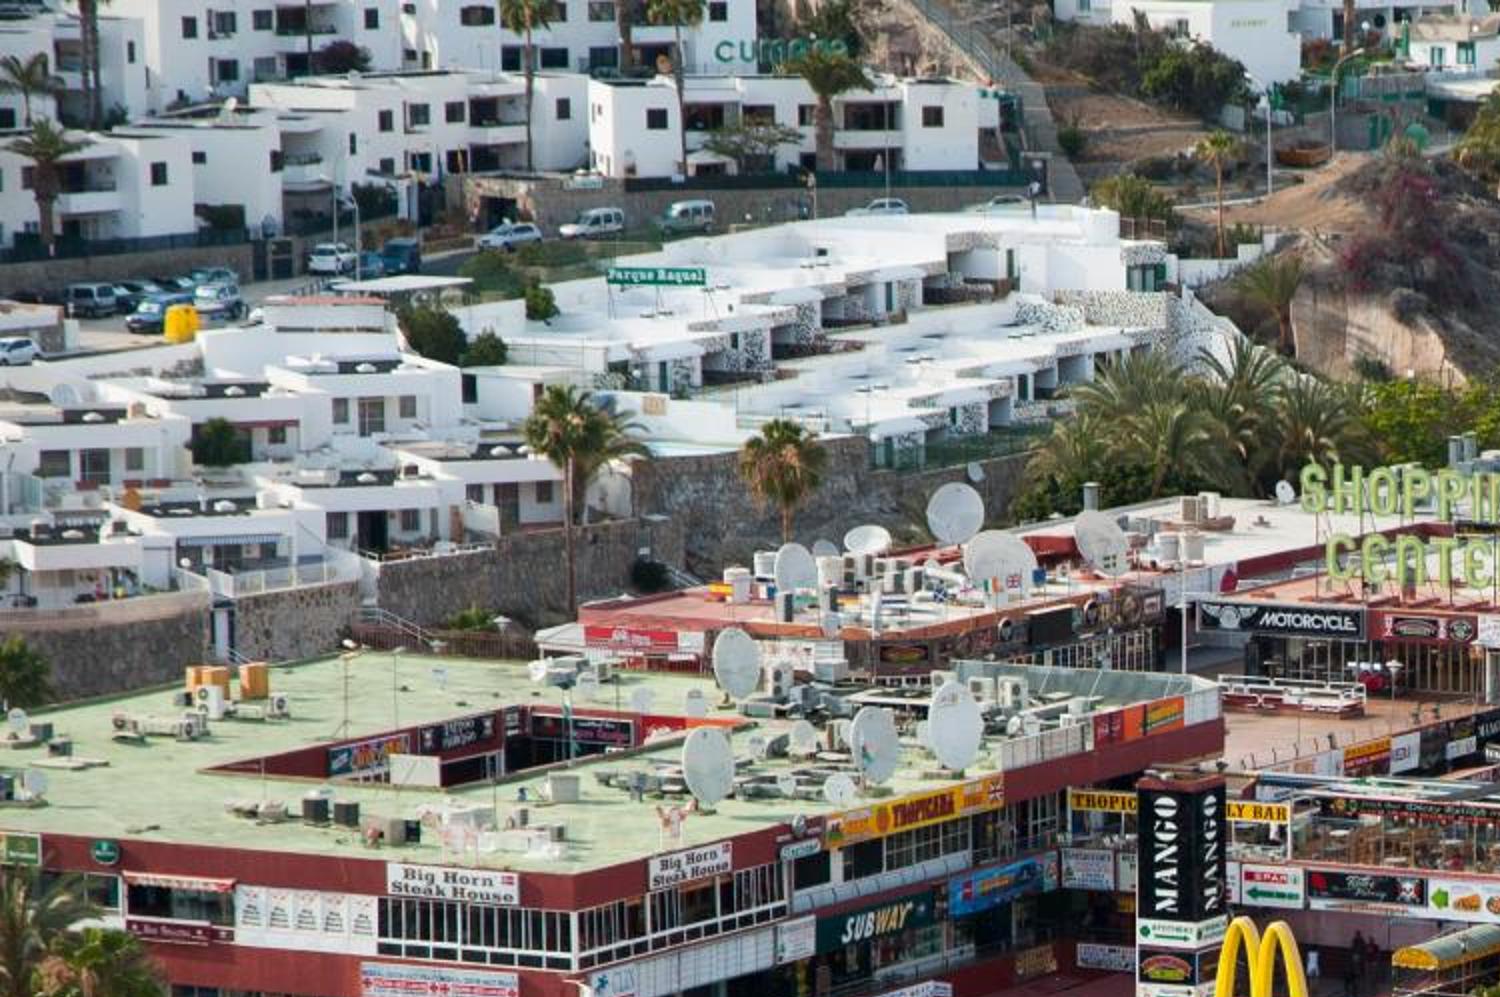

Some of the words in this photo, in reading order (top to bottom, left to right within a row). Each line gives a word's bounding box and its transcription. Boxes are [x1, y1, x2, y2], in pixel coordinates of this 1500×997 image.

[1259, 611, 1357, 632] MOTORCYCLE
[1252, 804, 1288, 821] BAR
[659, 857, 682, 873] Big
[685, 849, 718, 865] Horn
[1153, 796, 1179, 913] MANGO
[1202, 795, 1219, 912] MANGO
[402, 867, 436, 884] Big
[443, 871, 494, 887] Horn
[652, 871, 688, 888] Steak
[691, 861, 729, 879] House
[391, 881, 446, 897] Steak
[452, 887, 515, 902] House
[841, 902, 912, 944] SUBWAY
